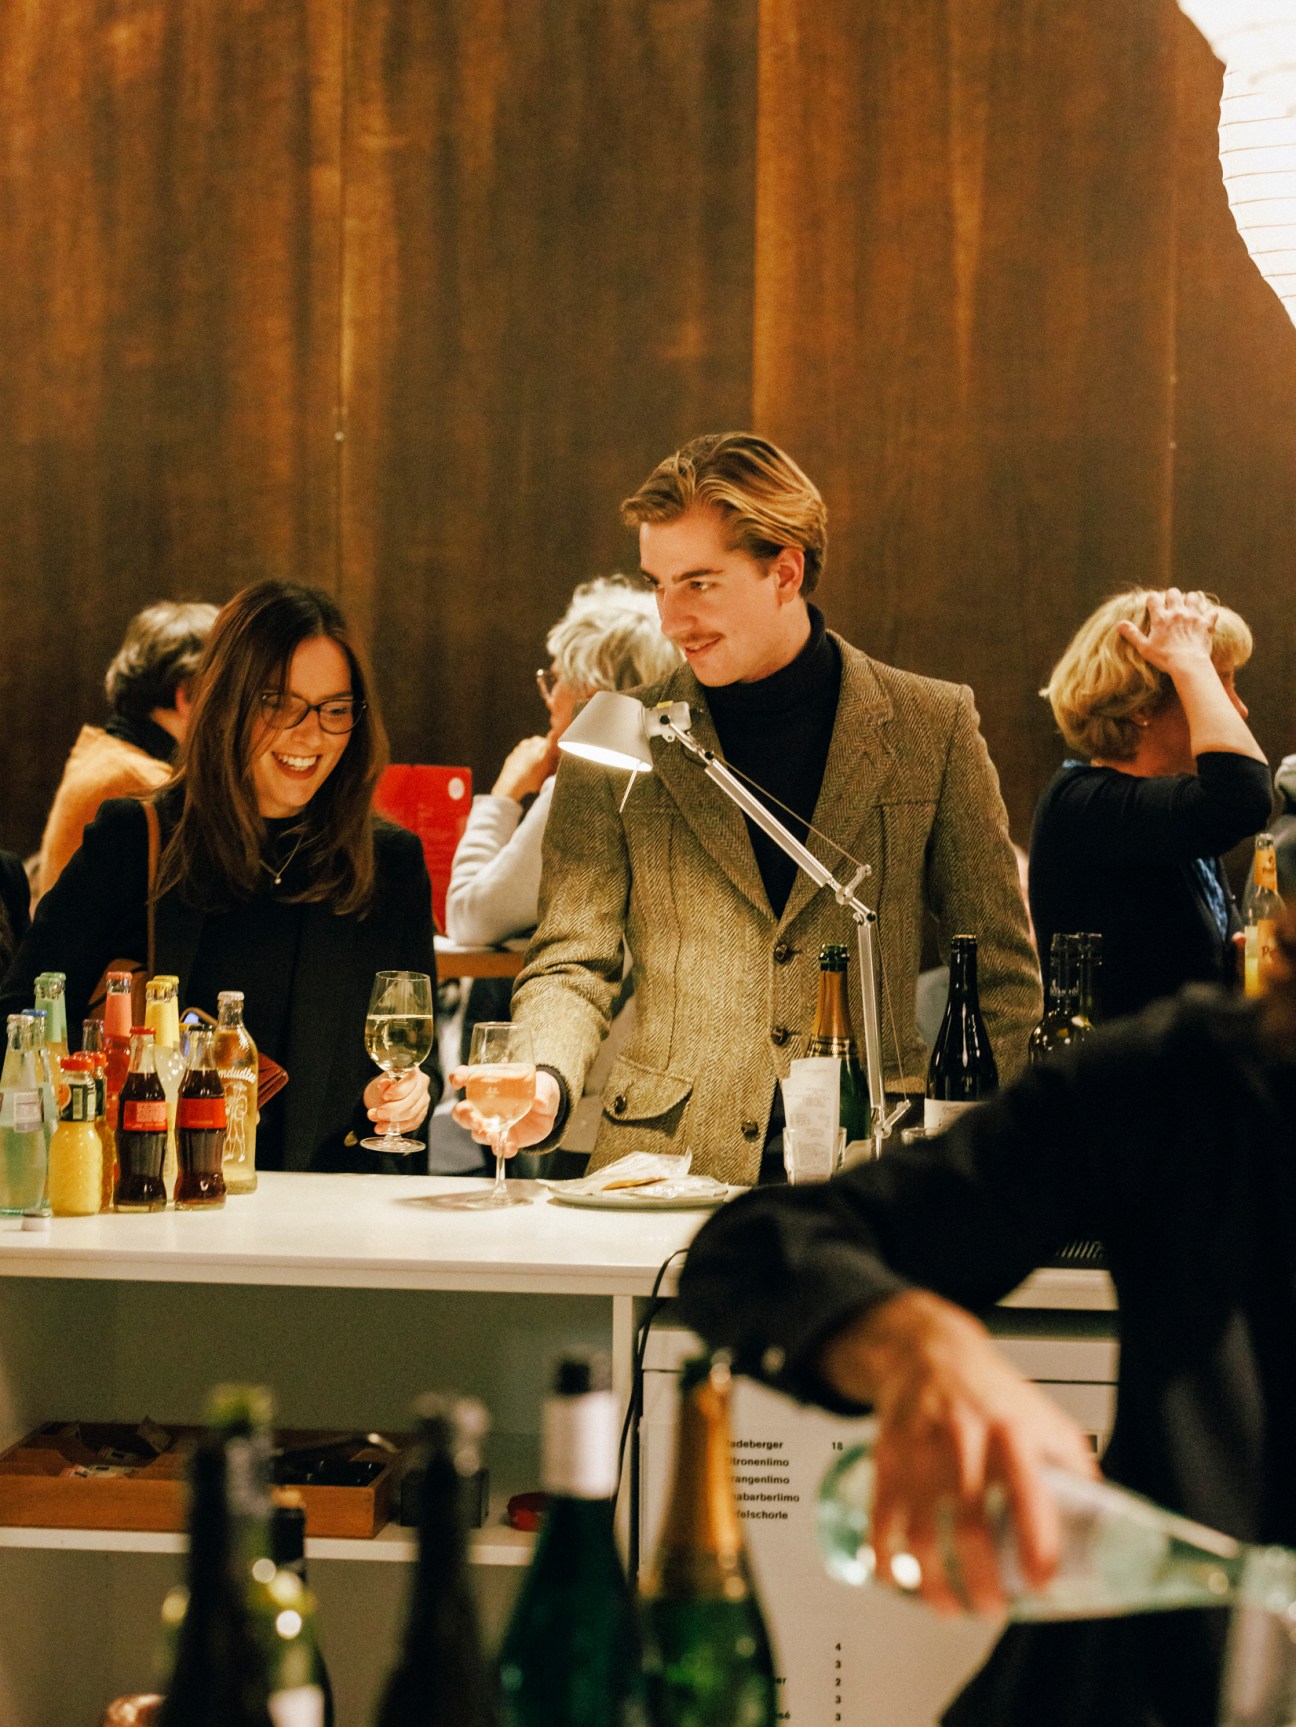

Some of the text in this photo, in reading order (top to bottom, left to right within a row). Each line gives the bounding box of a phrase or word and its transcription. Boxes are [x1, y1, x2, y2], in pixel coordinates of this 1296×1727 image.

[729, 1440, 843, 1450] adeberger 18
[730, 1457, 790, 1467] itronenlimo
[731, 1475, 790, 1485] rangenlimo
[732, 1492, 800, 1502] abarberlimo
[736, 1510, 788, 1519] felschorle
[835, 1677, 841, 1687] 2
